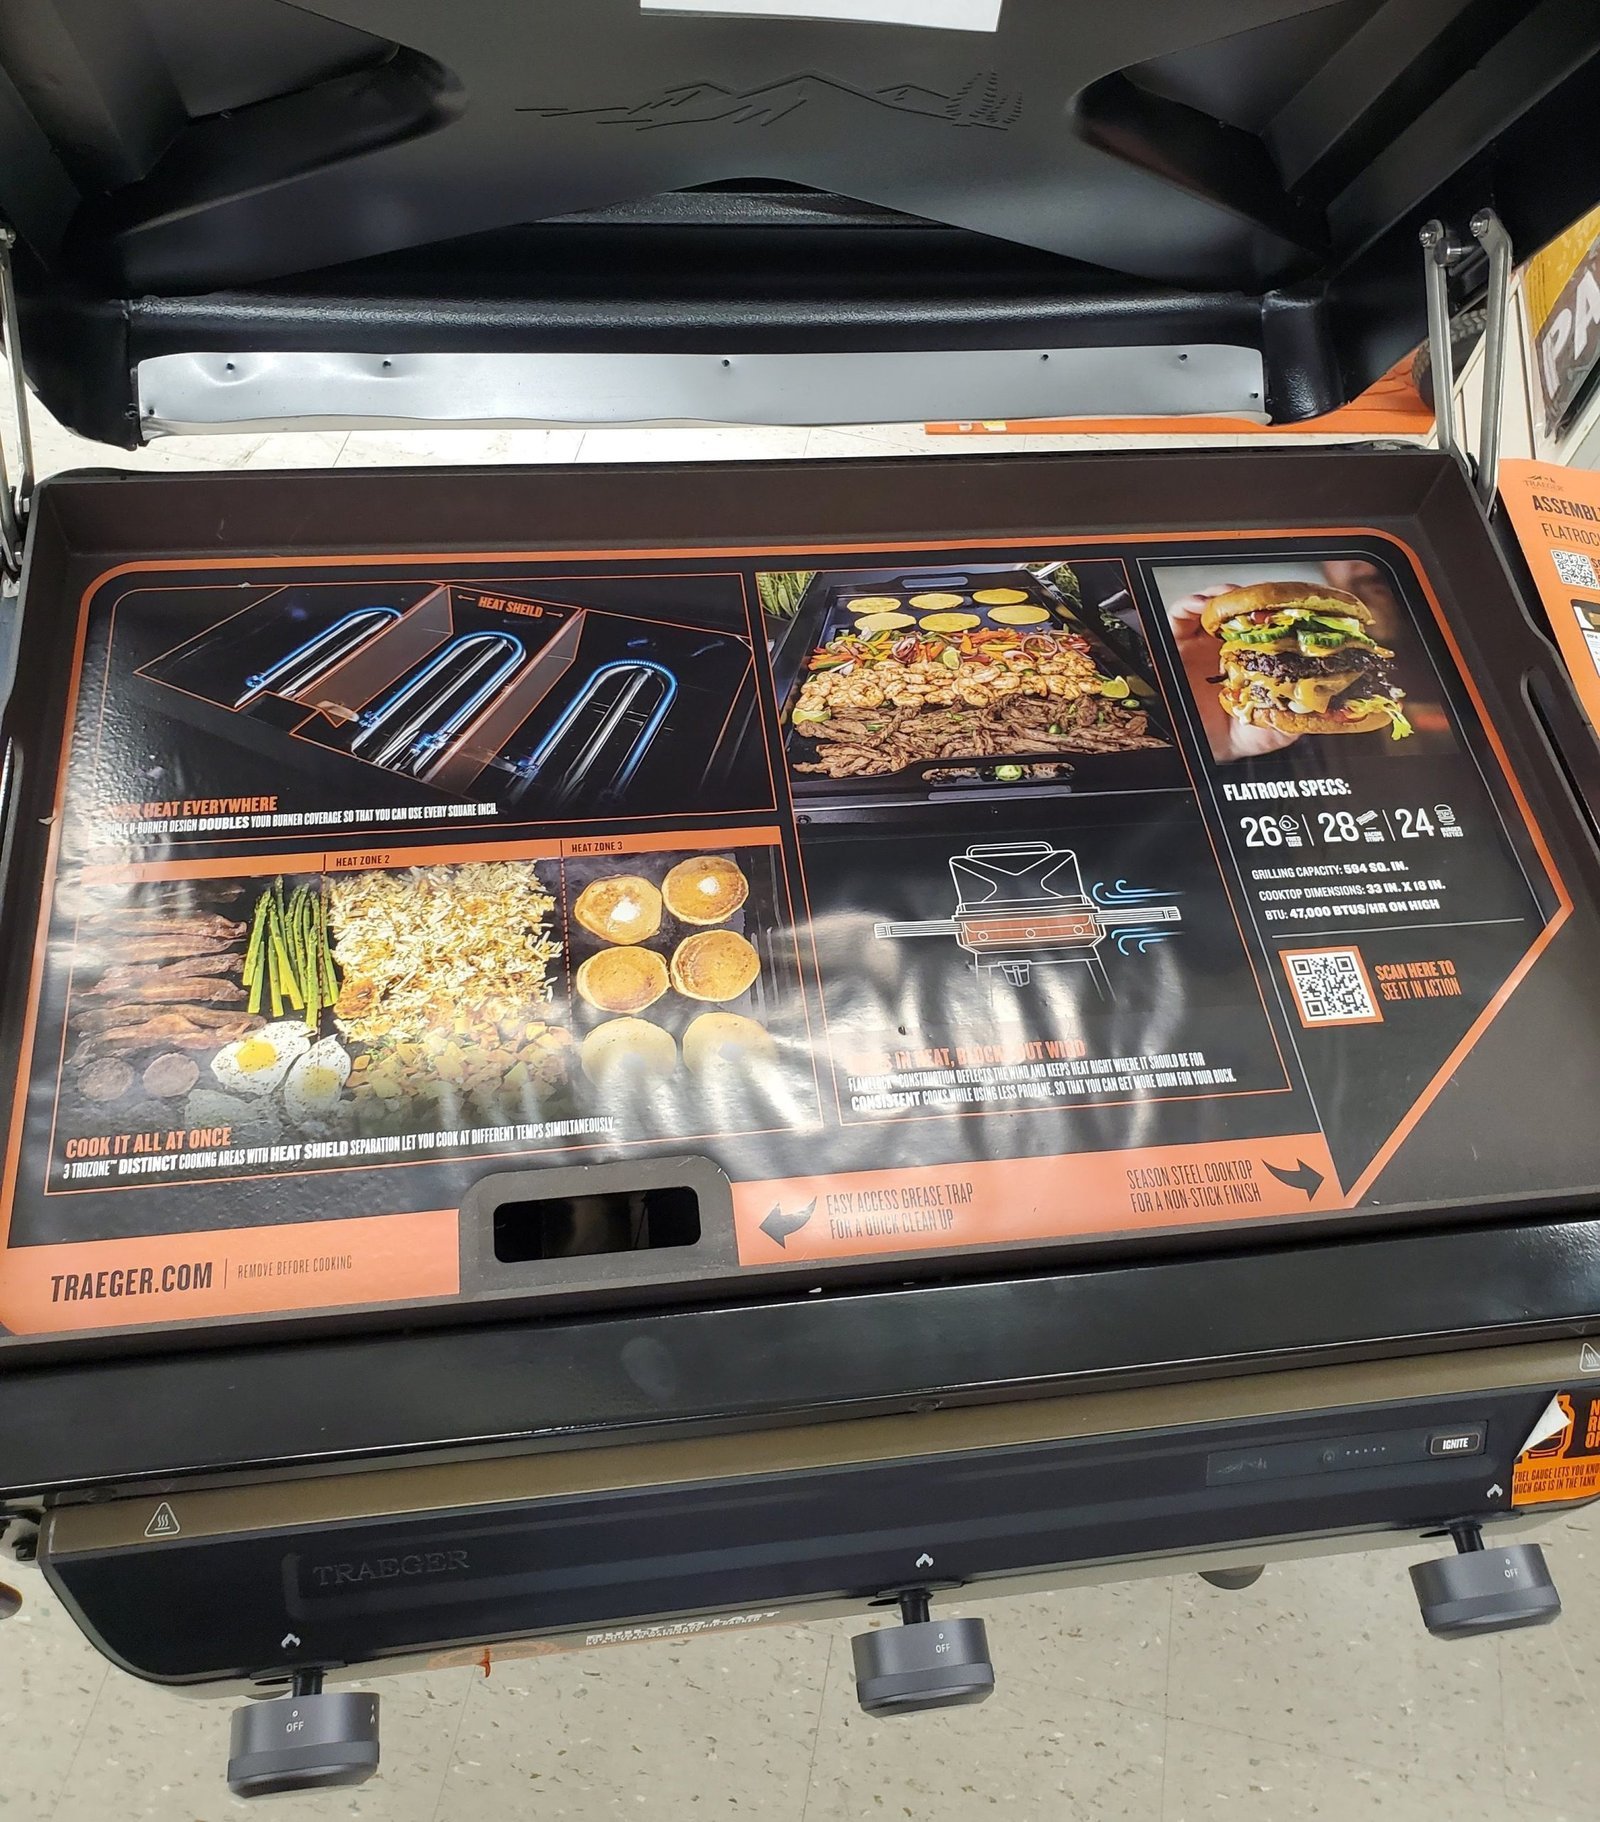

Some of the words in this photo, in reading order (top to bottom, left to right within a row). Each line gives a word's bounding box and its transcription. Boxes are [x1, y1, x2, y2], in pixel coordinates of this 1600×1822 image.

[478, 596, 505, 611] HEAT
[505, 601, 543, 618] SHEILD
[1222, 780, 1300, 801] FLATROCK
[1298, 778, 1352, 797] SPECS:
[130, 820, 168, 835] U-BURNER
[169, 818, 197, 833] DESIGN
[199, 816, 250, 831] DOUBLES
[251, 815, 271, 828] YOUR
[272, 813, 303, 827] BURNER
[304, 810, 342, 825] COVERAGE
[343, 810, 353, 823] SO
[355, 809, 375, 822] THAT
[375, 808, 391, 821] YOU
[391, 807, 407, 820] CAN
[408, 807, 423, 819] USE
[423, 805, 447, 819] EVERY
[448, 804, 477, 817] SQUARE
[477, 802, 498, 816] INCH.
[143, 801, 180, 818] HEAT
[182, 796, 278, 816] EVERYWHERE
[1240, 815, 1283, 848] 26
[1318, 811, 1360, 843] 28
[1394, 808, 1435, 838] 24
[571, 843, 592, 853] HEAT
[594, 842, 615, 852] ZONE
[617, 841, 623, 850] 3
[335, 856, 357, 867] HEAT
[359, 855, 382, 865] ZONE
[384, 854, 390, 864] 2
[1251, 867, 1295, 881] GRILLING
[1295, 864, 1343, 878] CAPACITY:
[1343, 863, 1367, 874] 594
[1368, 862, 1390, 873] SQ.
[1390, 860, 1409, 871] IN.
[1258, 888, 1302, 901] COOKTOP
[1305, 884, 1366, 899] DIMENSIONS:
[1366, 883, 1383, 895] 33
[1383, 882, 1400, 894] IN.
[1401, 881, 1413, 892] X
[1413, 881, 1427, 891] 18
[1428, 879, 1446, 890] IN.
[1265, 909, 1289, 921] BTU:
[1289, 905, 1331, 920] 47,000
[1332, 902, 1388, 916] BTUS/HR
[1388, 901, 1409, 912] ON
[1409, 899, 1440, 911] HIGH
[1374, 963, 1408, 981] SCAN
[1406, 961, 1439, 978] HERE
[1437, 959, 1456, 975] TO
[1380, 982, 1401, 1001] SEE
[1398, 981, 1411, 999] IT
[1409, 980, 1425, 998] IN
[1423, 977, 1462, 998] ACTION
[1044, 1039, 1086, 1059] WIND
[899, 1070, 956, 1088] CONSTRUCTION
[956, 1067, 992, 1083] DEFLECTS
[992, 1066, 1008, 1081] THE
[1008, 1064, 1028, 1080] WIND
[1030, 1063, 1046, 1078] AND
[1046, 1061, 1070, 1077] KEEPS
[1070, 1060, 1090, 1075] HEAT
[1091, 1058, 1114, 1074] RIGHT
[1113, 1056, 1140, 1072] WHERE
[1140, 1055, 1149, 1069] IT
[1149, 1053, 1179, 1069] SHOULD
[1179, 1053, 1188, 1067] BE
[1188, 1052, 1205, 1066] FOR
[851, 1091, 920, 1111] CONSISTENT
[922, 1089, 947, 1105] COOKS
[947, 1087, 973, 1103] WHILE
[973, 1086, 998, 1102] USING
[998, 1085, 1017, 1100] LESS
[1017, 1082, 1055, 1098] PROPANE,
[1055, 1081, 1066, 1096] SO
[1066, 1079, 1086, 1094] THAT
[1085, 1077, 1102, 1093] YOU
[1102, 1076, 1119, 1092] CAN
[1118, 1075, 1134, 1090] GET
[1133, 1073, 1156, 1089] MORE
[1156, 1072, 1177, 1088] BURN
[1177, 1071, 1192, 1086] FOR
[1192, 1070, 1214, 1084] YOUR
[1213, 1068, 1237, 1083] BUCK.
[63, 1163, 70, 1179] 3
[118, 1154, 178, 1175] DISTINCT
[178, 1152, 216, 1170] COOKING
[217, 1150, 246, 1167] AREAS
[246, 1147, 268, 1164] WITH
[270, 1144, 302, 1162] HEAT
[304, 1140, 348, 1159] SHIELD
[350, 1136, 400, 1155] SEPARATION
[401, 1134, 417, 1151] LET
[417, 1132, 434, 1150] YOU
[436, 1131, 459, 1148] COOK
[459, 1130, 470, 1146] AT
[471, 1125, 515, 1145] DIFFERENT
[515, 1122, 544, 1141] TEMPS
[66, 1139, 110, 1159] COOK
[113, 1135, 131, 1155] IT
[132, 1133, 162, 1153] ALL
[165, 1130, 186, 1150] AT
[188, 1127, 233, 1149] ONCE
[1126, 1166, 1171, 1190] SEASON
[1170, 1163, 1204, 1185] STEEL
[1204, 1159, 1253, 1183] COOKTOP
[826, 1193, 854, 1216] EASY
[857, 1189, 900, 1213] ACCESS
[901, 1185, 944, 1209] GREASE
[945, 1182, 973, 1205] TRAP
[1130, 1191, 1153, 1213] FOR
[1155, 1191, 1164, 1212] A
[1163, 1185, 1223, 1210] NON-STICK
[1223, 1182, 1262, 1205] FINISH
[829, 1219, 853, 1240] FOR
[856, 1218, 863, 1238] A
[865, 1213, 900, 1236] QUICK
[901, 1209, 937, 1233] CLEAN
[937, 1208, 954, 1230] UP
[238, 1262, 273, 1279] REMOVE
[277, 1258, 310, 1277] BEFORE
[313, 1254, 352, 1274] COOKING
[50, 1261, 213, 1303] TRAEGER.COM
[1442, 1437, 1469, 1450] IGNITE
[1515, 1471, 1529, 1482] FUEL
[1532, 1468, 1552, 1480] GAUGE
[1554, 1466, 1569, 1478] LETS
[1571, 1464, 1584, 1476] YOU
[1534, 1480, 1547, 1492] GAS
[1548, 1479, 1555, 1490] IS
[1556, 1478, 1563, 1489] IN
[1565, 1477, 1577, 1488] THE
[1579, 1475, 1596, 1487] TANK
[312, 1550, 470, 1586] TRAEGER
[1504, 1568, 1519, 1578] OFF
[936, 1643, 950, 1653] OFF
[286, 1721, 304, 1733] OFF
